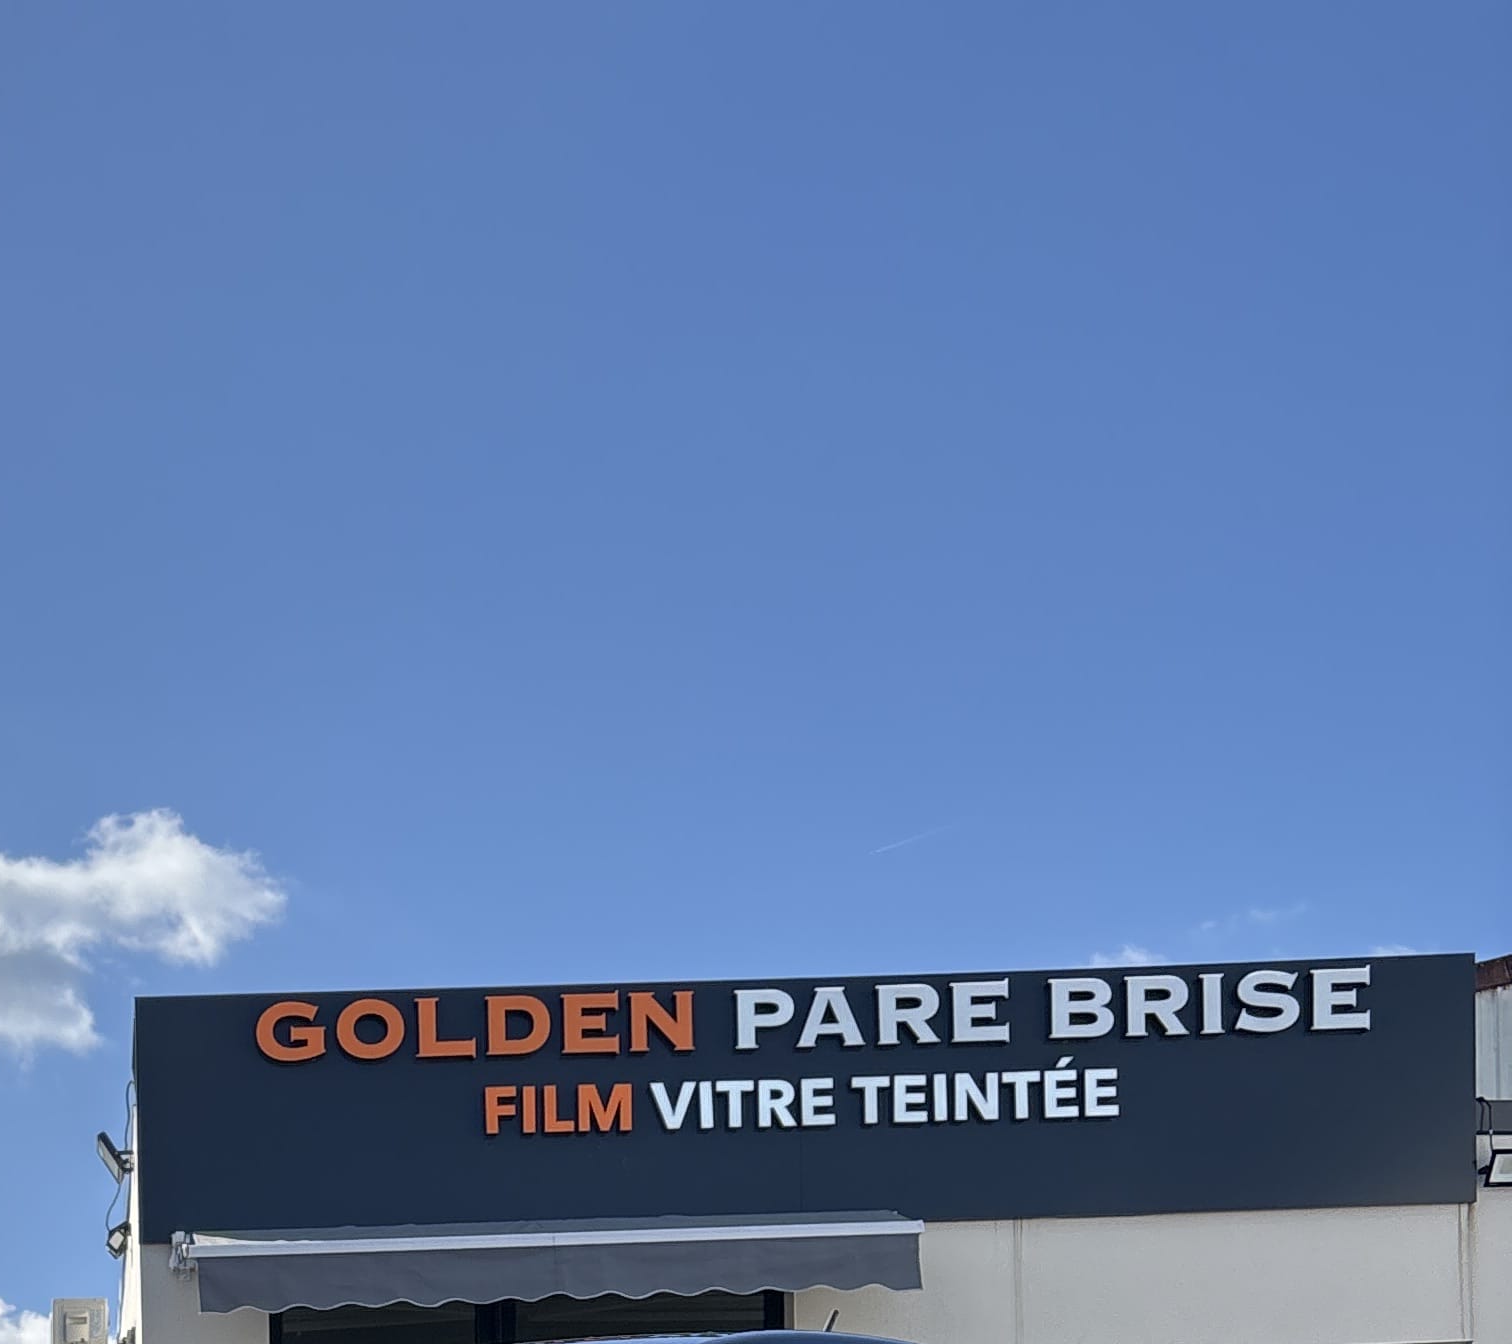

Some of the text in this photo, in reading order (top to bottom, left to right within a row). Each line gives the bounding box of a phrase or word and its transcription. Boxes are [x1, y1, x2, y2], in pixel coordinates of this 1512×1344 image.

[255, 963, 1372, 1062] GOLDEN PARE BRISE
[484, 1055, 1121, 1135] FILM VITRE TEINTÉE
